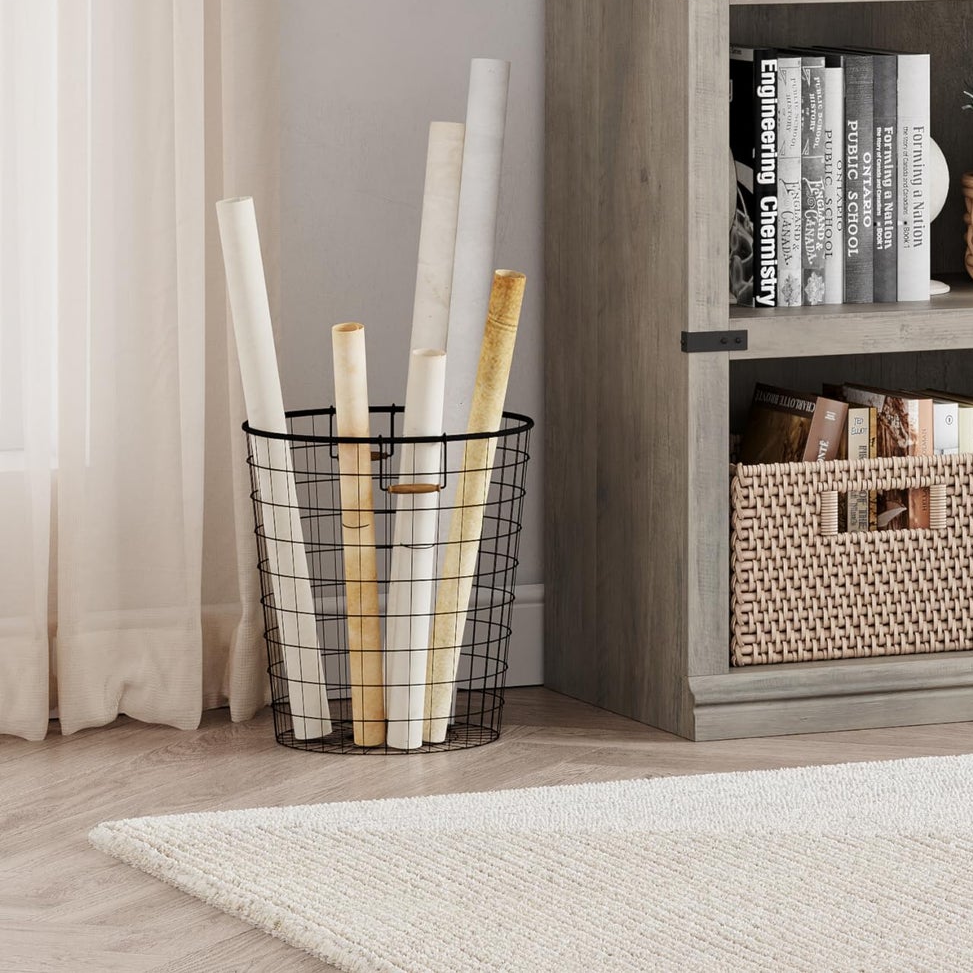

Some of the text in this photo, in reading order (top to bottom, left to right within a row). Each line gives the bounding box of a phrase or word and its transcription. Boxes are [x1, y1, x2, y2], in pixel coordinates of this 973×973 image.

[812, 77, 822, 149] PUBLIC SCHOOL
[756, 59, 778, 307] Engineering Chemistry
[848, 120, 858, 257] PUBLIC SCHOOL
[862, 152, 872, 227] ONTARIO
[882, 127, 894, 249] Forming a Nation
[910, 127, 926, 185] Forming
[779, 179, 800, 251] ENGLAND &
[802, 177, 824, 251] ENGLAND &
[913, 202, 926, 247] Nation
